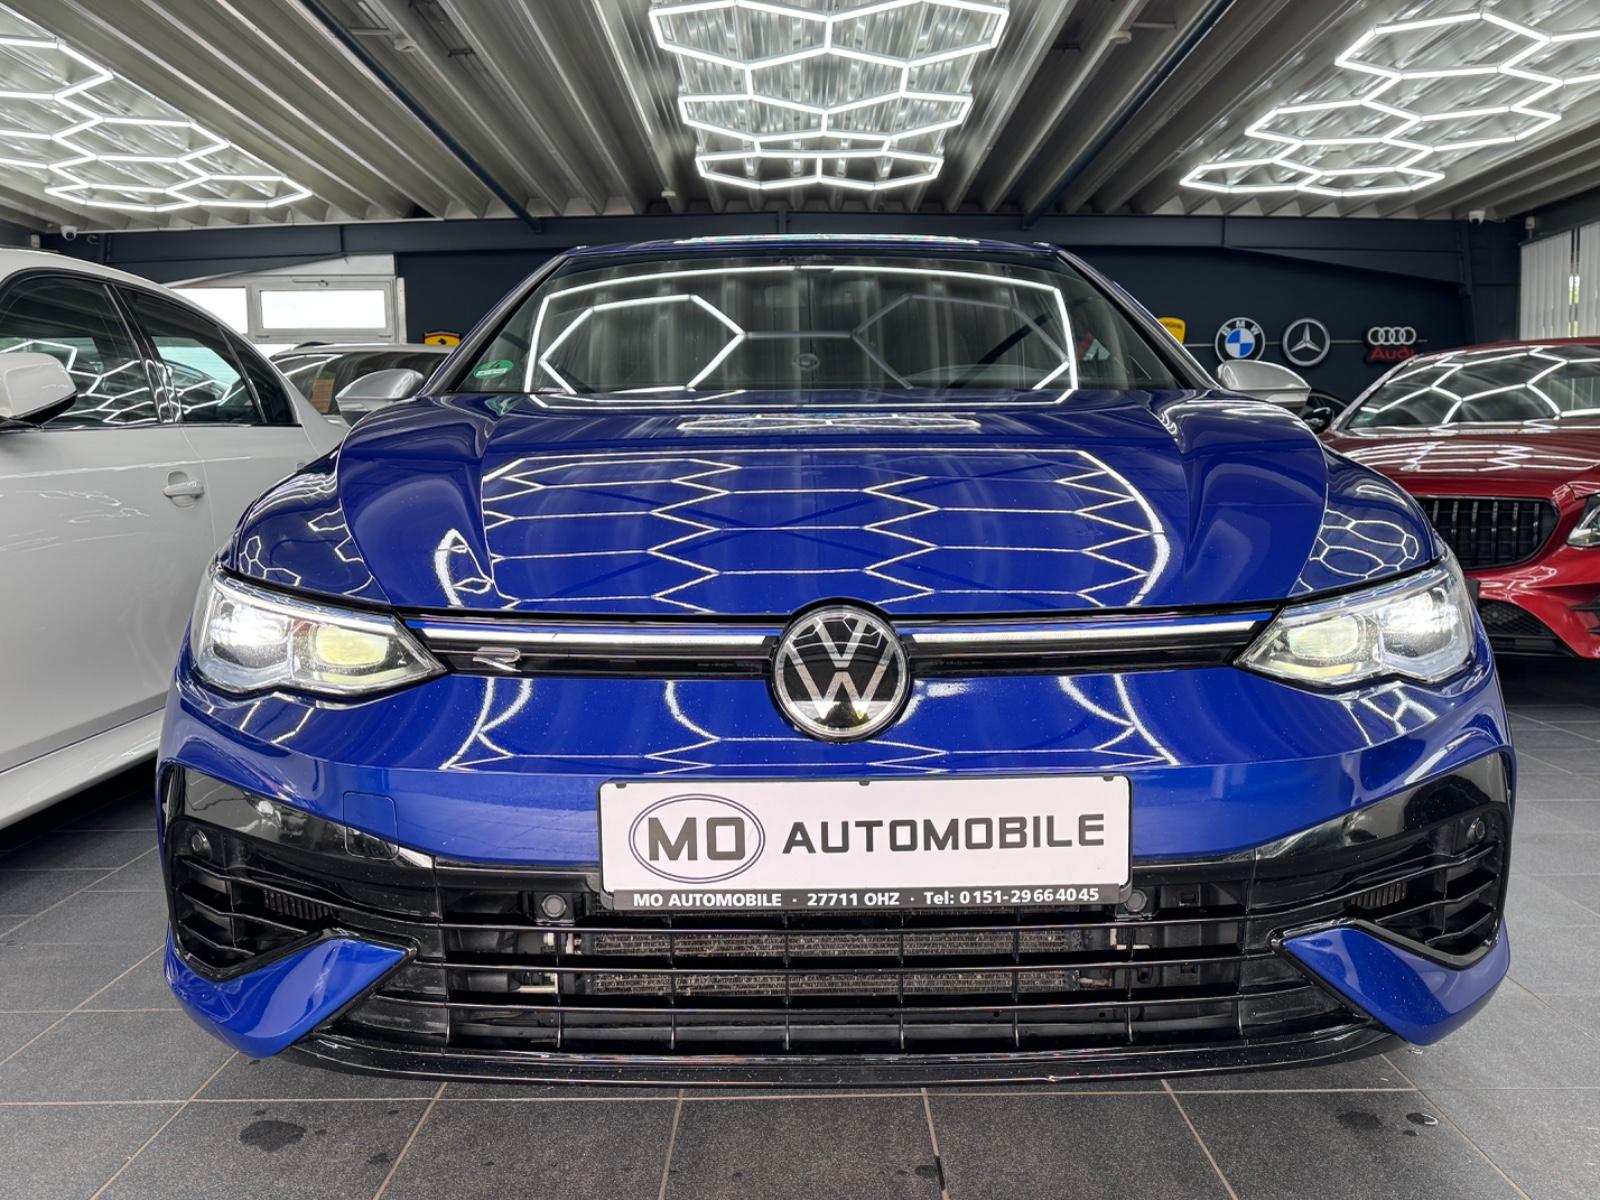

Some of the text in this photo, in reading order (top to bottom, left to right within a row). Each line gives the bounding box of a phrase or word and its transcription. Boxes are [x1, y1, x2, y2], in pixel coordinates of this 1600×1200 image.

[1221, 319, 1261, 336] BMW
[648, 813, 1105, 861] MO AUTOMOBILE
[633, 893, 664, 907] MO
[667, 893, 782, 907] AUTOMOBILE
[807, 893, 858, 906] 27711
[864, 892, 900, 906] OHZ
[923, 891, 955, 905] Tel:
